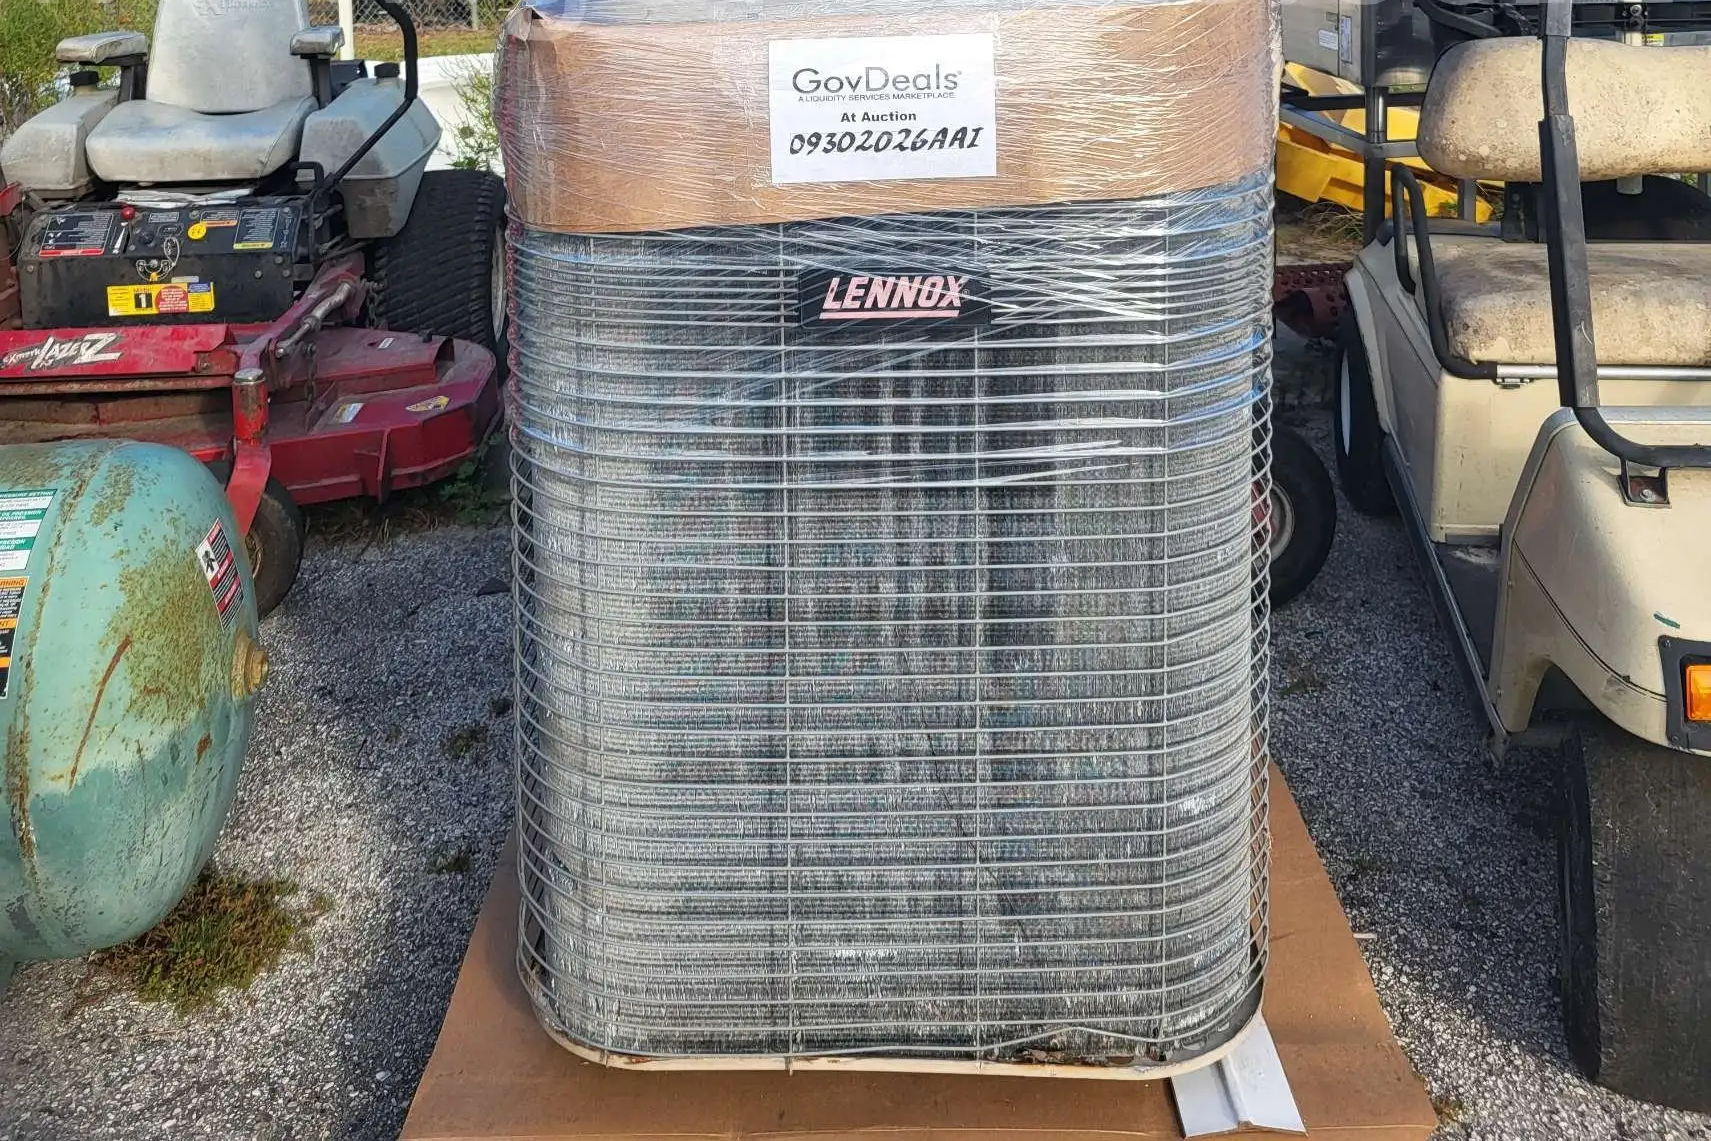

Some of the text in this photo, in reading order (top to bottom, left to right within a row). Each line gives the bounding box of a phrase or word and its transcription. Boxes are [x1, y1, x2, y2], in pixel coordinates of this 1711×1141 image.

[792, 63, 959, 94] GovDeals
[848, 93, 891, 101] SERVICES
[892, 92, 955, 100] MARKETPLACE
[840, 111, 917, 122] At Auction
[822, 275, 969, 309] LENNOX
